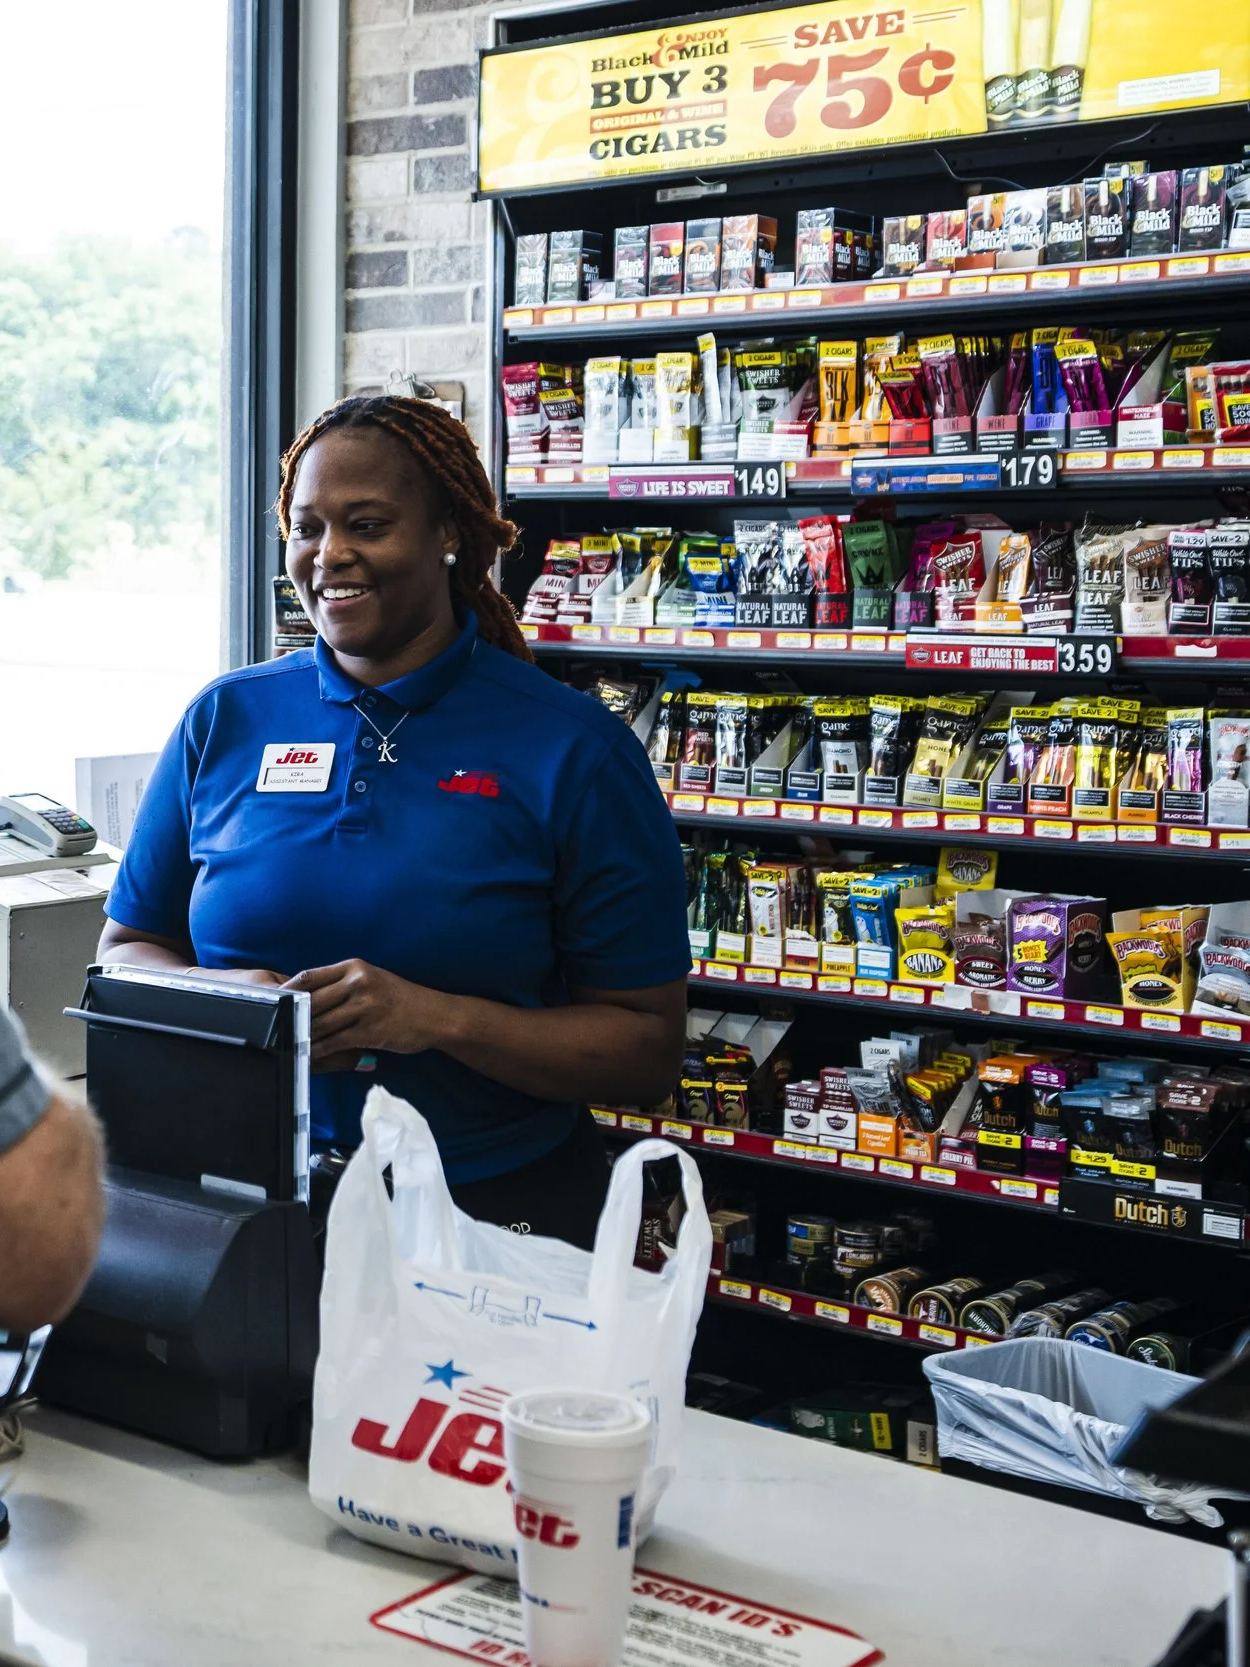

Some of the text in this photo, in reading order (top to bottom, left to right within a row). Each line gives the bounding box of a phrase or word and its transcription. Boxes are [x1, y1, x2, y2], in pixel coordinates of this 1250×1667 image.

[794, 9, 905, 49] SAVE
[591, 52, 654, 73] Black
[679, 41, 729, 60] Mild
[590, 65, 728, 109] BUY 3
[753, 42, 956, 138] 75¢
[593, 108, 664, 129] ORIGINAL
[682, 102, 724, 118] WINE
[590, 124, 727, 161] CIGARS
[855, 137, 884, 146] excludes
[887, 131, 928, 143] promotional
[931, 128, 962, 140] products
[1137, 209, 1170, 222] Black
[1186, 204, 1220, 217] Black
[1051, 220, 1082, 233] Black
[1090, 215, 1122, 227] Black
[1144, 219, 1170, 231] Mild
[1195, 214, 1220, 227] Mild
[973, 229, 1003, 241] Black
[1009, 224, 1041, 237] Black
[1057, 229, 1083, 243] Mild
[1097, 224, 1123, 237] Mild
[932, 238, 961, 249] Black
[1014, 232, 1041, 244] Mild
[889, 242, 919, 254] Black
[977, 239, 1003, 251] Mild
[894, 251, 919, 263] Mild
[938, 246, 965, 258] Mild
[826, 346, 853, 356] 2 CIGARS
[923, 338, 953, 351] 2 CIGARS
[749, 352, 776, 362] 2 CIGARS
[745, 369, 780, 378] SWISHER
[748, 376, 779, 385] SWEETS
[508, 388, 536, 397] SWEETS
[551, 442, 581, 450] CIGARILLOS
[642, 482, 669, 495] LIFE
[672, 481, 685, 495] IS
[688, 480, 730, 495] SWEET
[935, 547, 974, 566] SWISHER
[1213, 549, 1229, 557] White
[1213, 558, 1245, 567] TIPS
[1084, 570, 1123, 585] LEAF
[941, 578, 976, 591] LEAF
[1082, 592, 1112, 605] LEAF
[774, 603, 807, 612] NATURAL
[1034, 602, 1054, 613] LEAF
[736, 609, 770, 624] LEAF
[774, 609, 807, 624] LEAF
[934, 651, 964, 664] LEAF
[971, 648, 987, 658] GET
[988, 648, 1012, 658] BACK
[1014, 649, 1025, 658] TO
[971, 658, 1054, 670] ENJOYING THE BEST
[818, 707, 838, 715] SAVE
[939, 701, 957, 709] SAVE
[821, 720, 850, 736] game
[926, 716, 964, 731] game
[378, 742, 398, 763] K
[826, 963, 851, 972] PINEAPPLE
[906, 956, 945, 971] BANANA
[968, 972, 996, 980] AROMATIC
[1023, 976, 1047, 984] BERRY
[787, 1094, 815, 1105] SWISHER
[788, 1102, 813, 1111] SWEETS
[984, 1111, 1016, 1127] Dutch
[1165, 1139, 1202, 1156] Dutch
[941, 1153, 973, 1165] CHERRY PIE
[1114, 1198, 1169, 1226] Dutch
[351, 1396, 516, 1494] Je
[338, 1496, 506, 1561] Have a Great
[631, 1574, 727, 1617] SCAN
